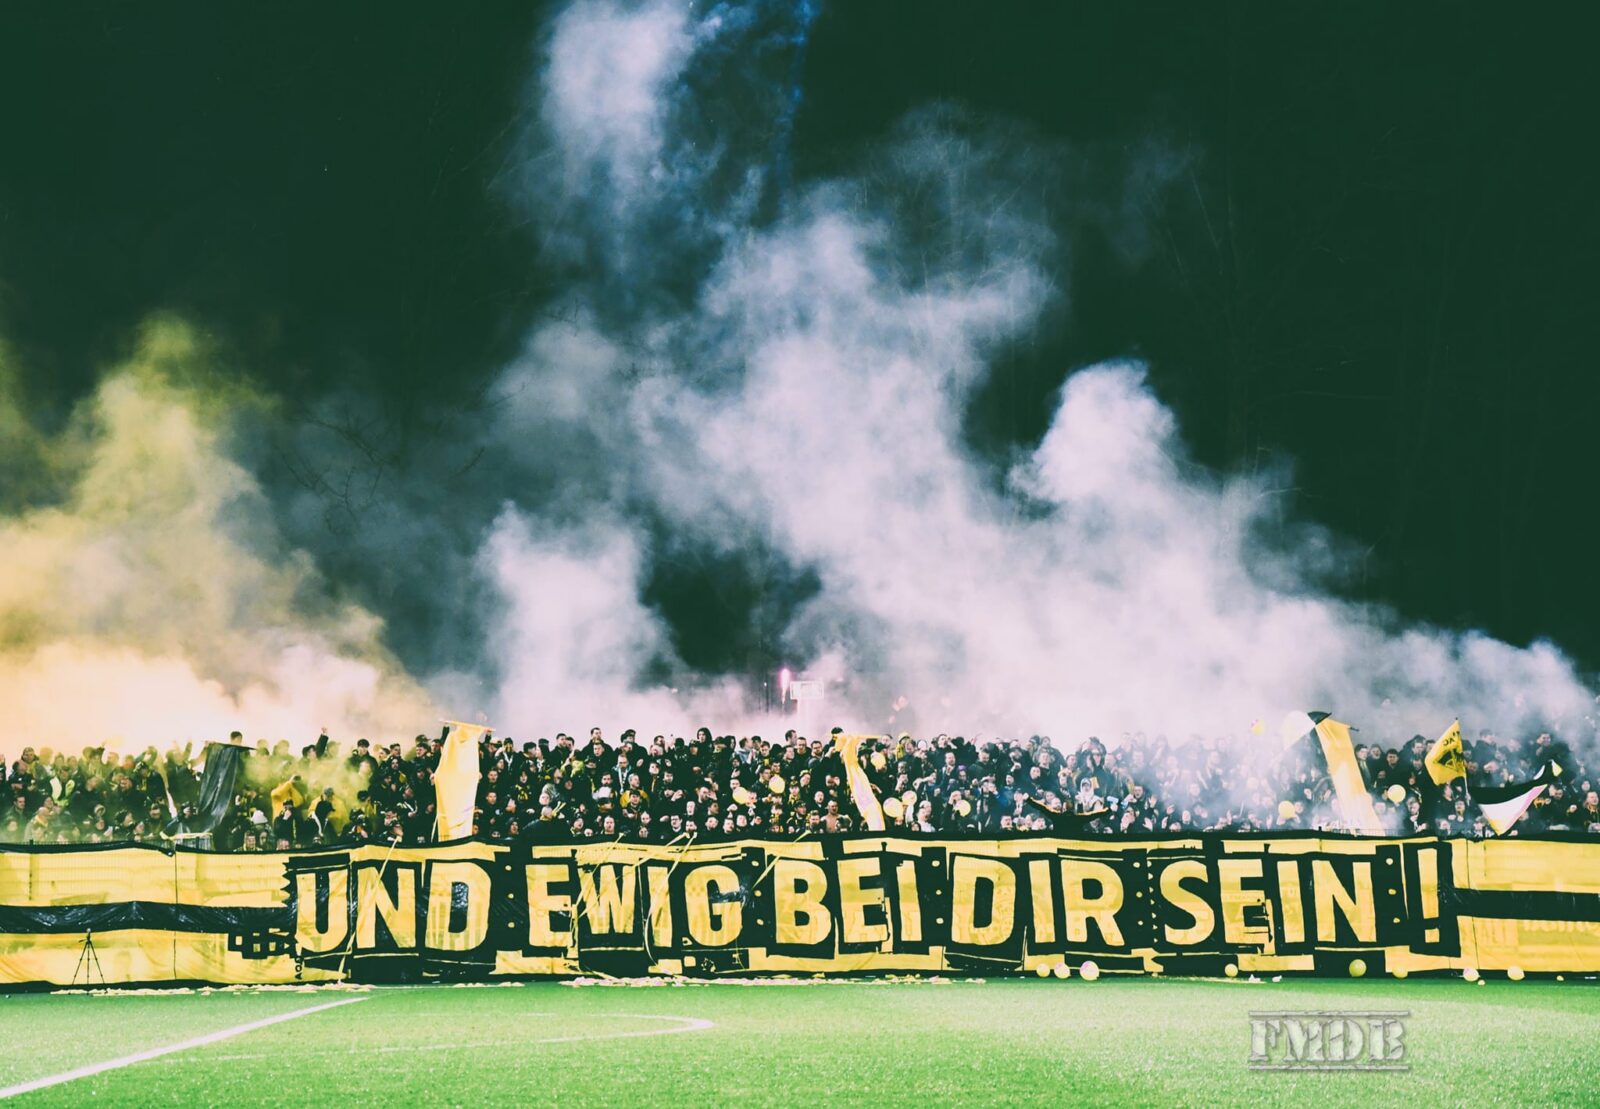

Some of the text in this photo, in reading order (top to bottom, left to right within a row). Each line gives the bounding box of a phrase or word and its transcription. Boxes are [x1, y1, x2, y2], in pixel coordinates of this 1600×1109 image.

[296, 863, 492, 952] UND
[525, 864, 742, 948] EWIG
[775, 858, 922, 945] BEI
[950, 855, 1125, 946] DIR
[1159, 858, 1377, 946] SEIN
